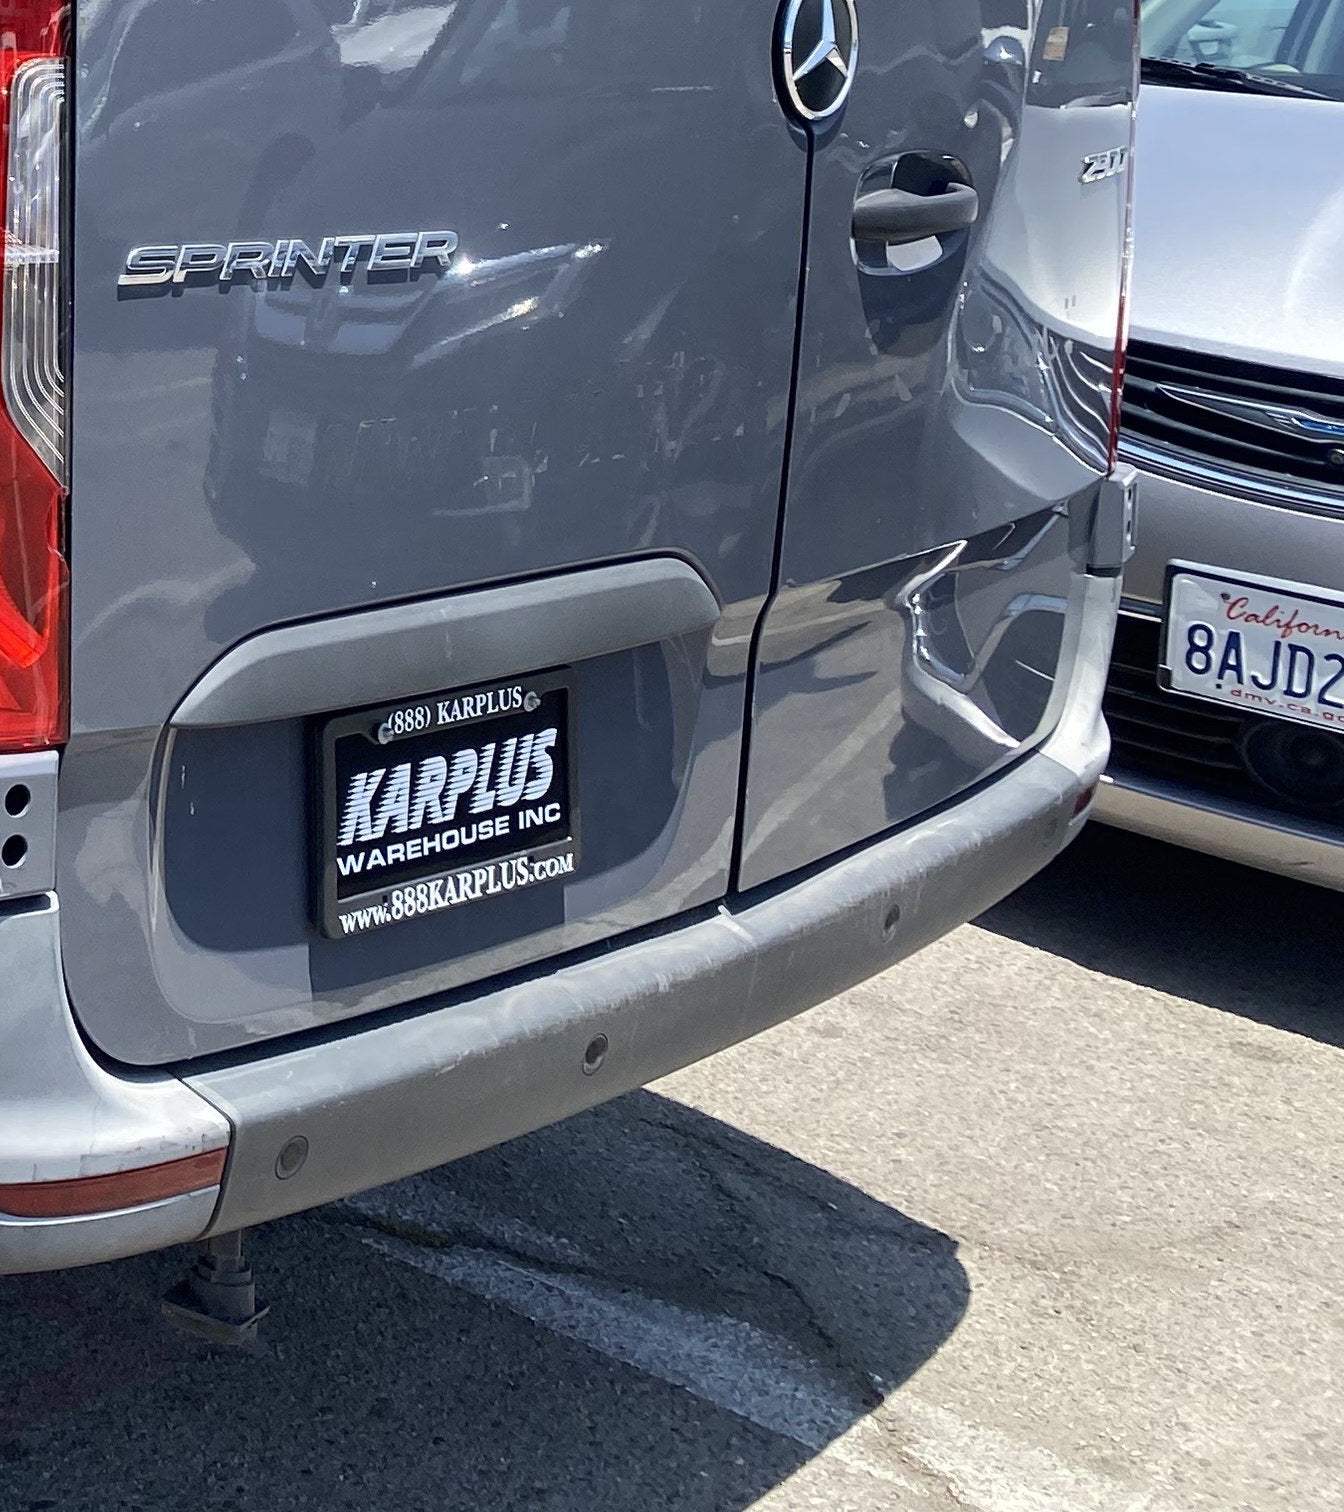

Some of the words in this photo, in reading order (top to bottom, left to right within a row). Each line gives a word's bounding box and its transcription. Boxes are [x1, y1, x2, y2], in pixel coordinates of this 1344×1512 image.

[117, 229, 460, 287] SPRINTER
[1185, 623, 1344, 710] 8AJD2
[387, 705, 432, 736] (888)
[437, 685, 523, 727] KARPLUS
[336, 727, 558, 847] KARPLUS
[335, 814, 510, 876] WAREHOUSE
[518, 801, 562, 831] INC
